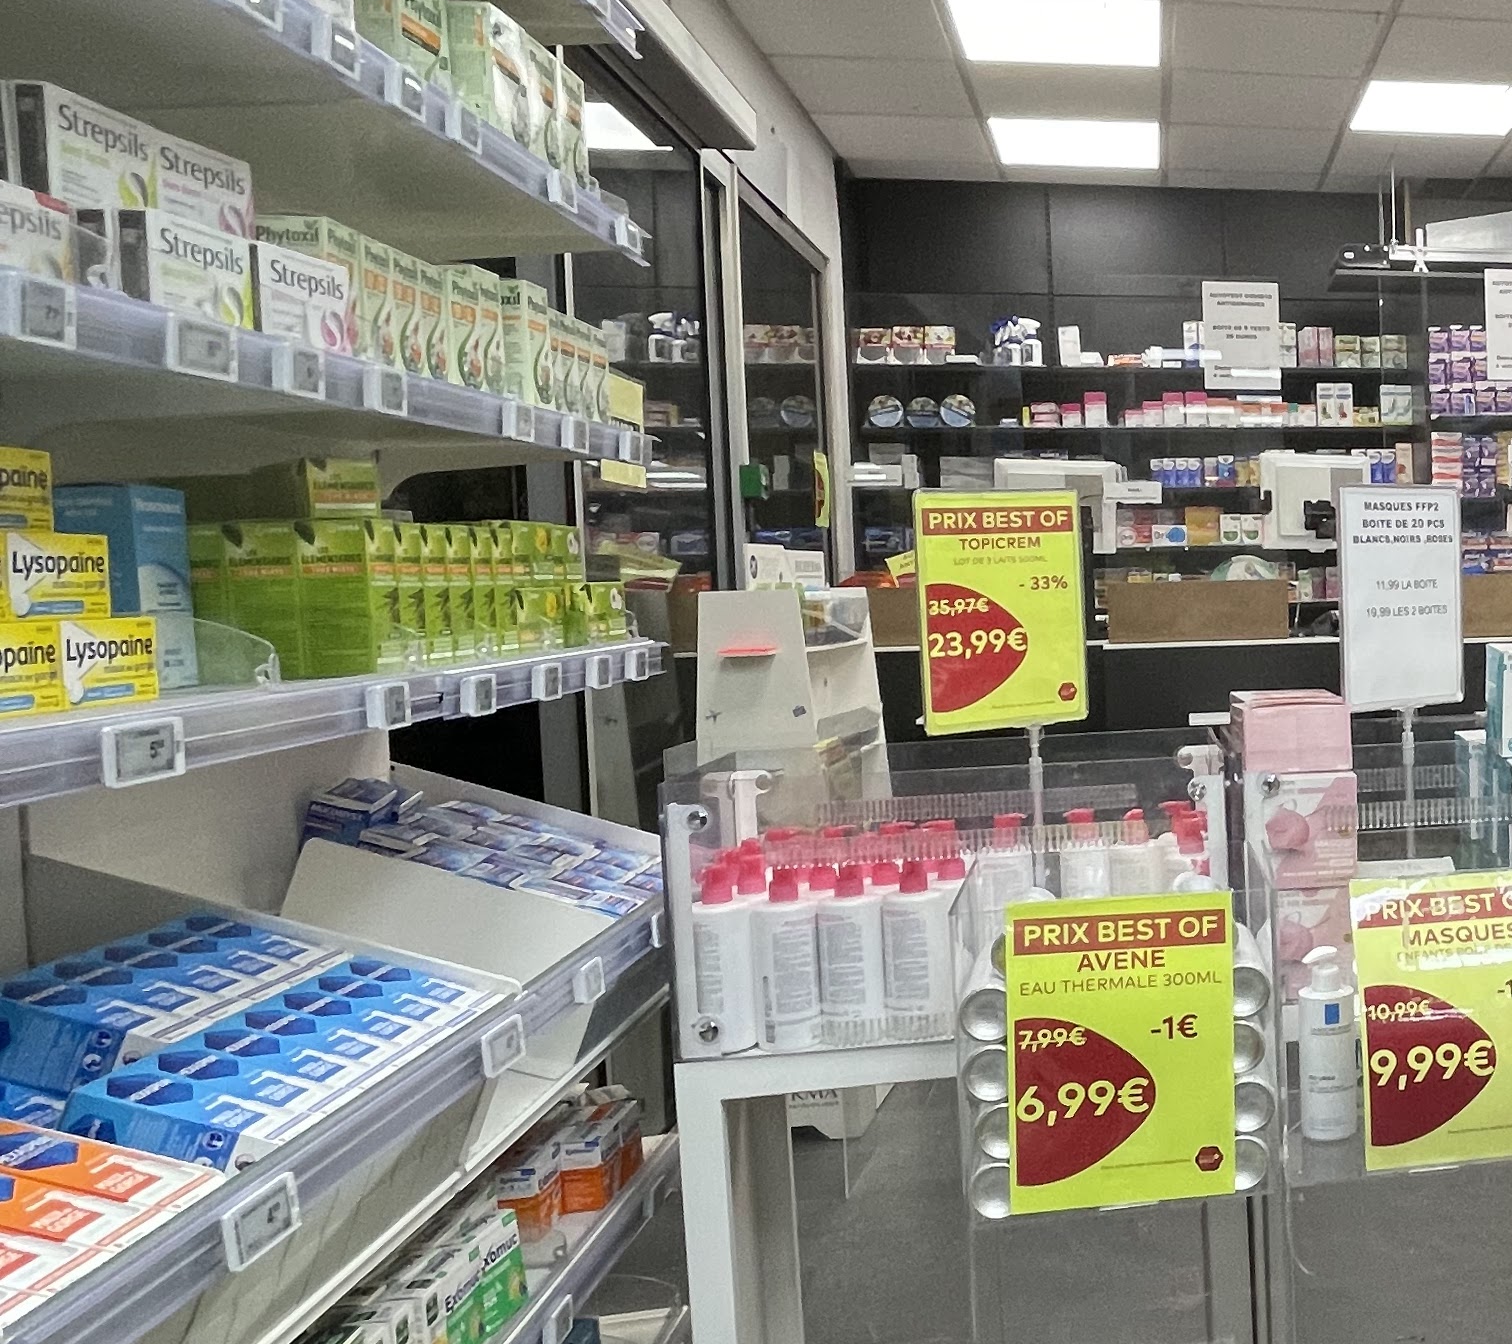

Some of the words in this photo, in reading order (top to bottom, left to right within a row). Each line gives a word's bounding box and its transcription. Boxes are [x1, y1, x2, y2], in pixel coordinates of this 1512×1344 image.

[58, 104, 149, 161] Strepsils
[160, 146, 246, 195] Strepsils
[160, 228, 244, 275] Strepsils
[270, 259, 344, 301] Strepsils
[928, 512, 977, 530] PRIX
[982, 511, 1036, 529] BEST
[1040, 510, 1069, 527] OF
[1364, 502, 1413, 512] MASQUES
[1415, 502, 1439, 511] FFP2
[1362, 519, 1392, 528] BOITE
[1395, 519, 1408, 528] DE
[1411, 519, 1425, 528] 20
[1427, 519, 1445, 528] PCS
[959, 536, 1041, 551] TOPICREM
[1030, 575, 1068, 591] 33%
[1401, 580, 1412, 590] LA
[928, 597, 989, 617] 35,97€
[1393, 606, 1409, 617] LES
[1411, 606, 1417, 616] 2
[928, 627, 1028, 660] 23,99€
[1365, 898, 1426, 922] PRIX
[1429, 893, 1494, 916] BEST
[1023, 922, 1089, 947] PRIX
[1097, 917, 1172, 944] BEST
[1178, 914, 1219, 939] OF
[1077, 949, 1166, 973] AVENE
[1019, 981, 1057, 997] EAU
[1062, 973, 1158, 993] THERMALE
[1163, 971, 1222, 988] 300ML
[1018, 1027, 1088, 1052] 7,99€
[1150, 1014, 1199, 1040] -1€
[1370, 1039, 1496, 1091] 9,99€
[1016, 1077, 1150, 1127] 6,99€
